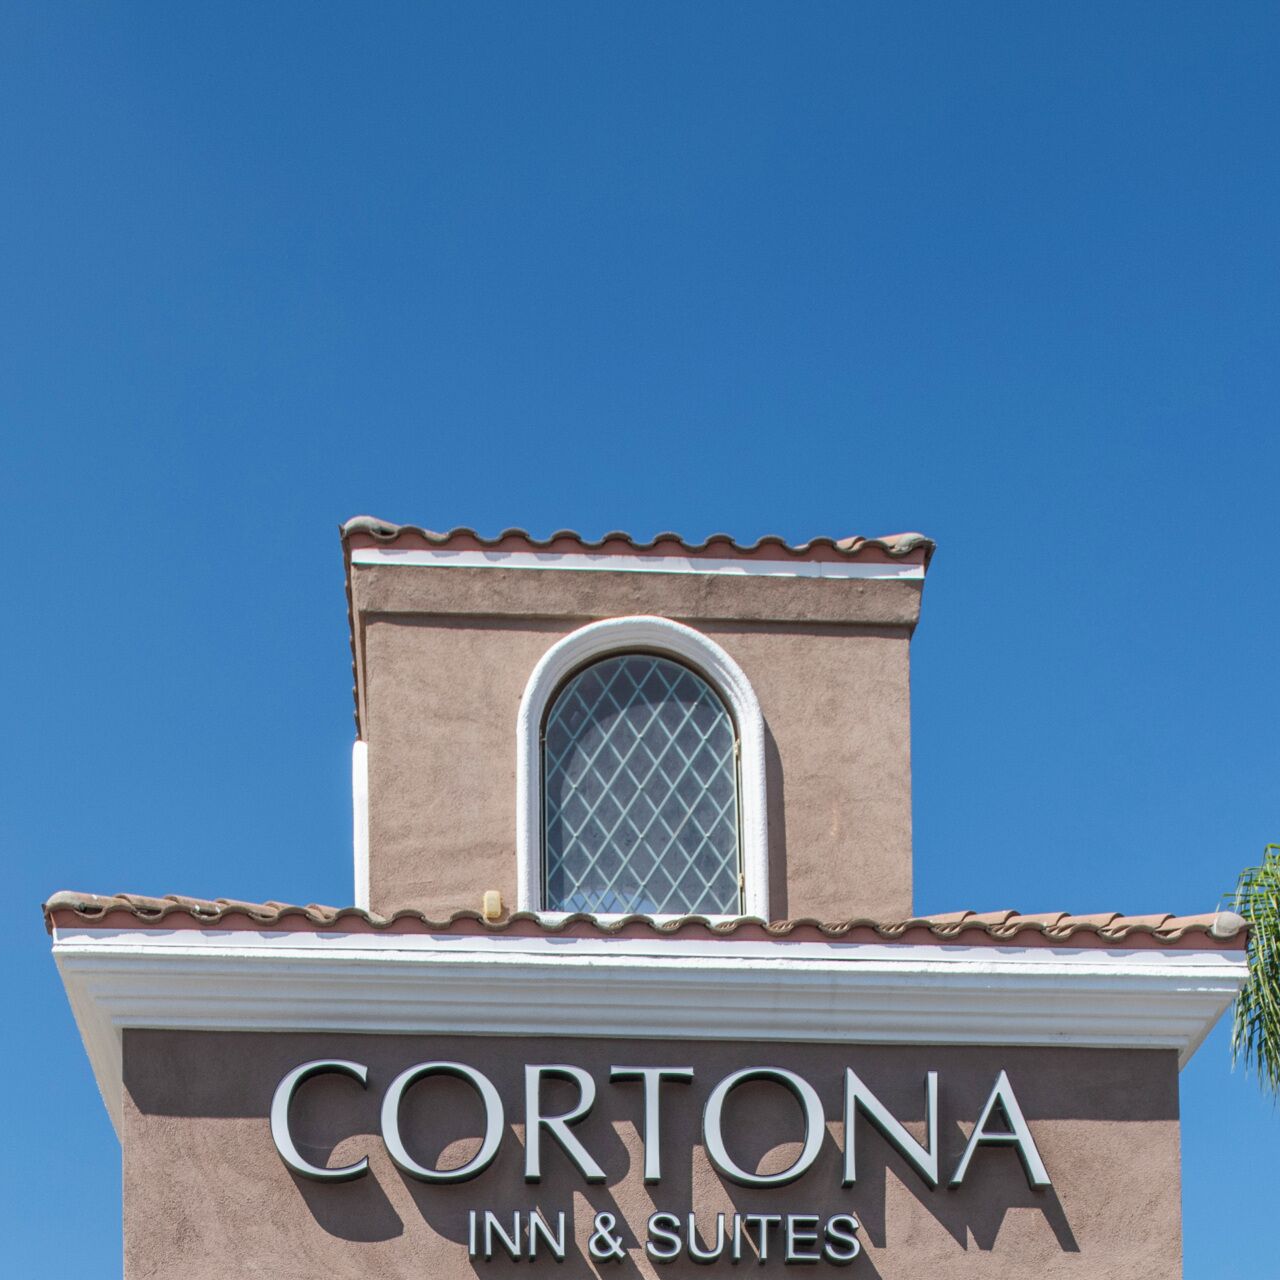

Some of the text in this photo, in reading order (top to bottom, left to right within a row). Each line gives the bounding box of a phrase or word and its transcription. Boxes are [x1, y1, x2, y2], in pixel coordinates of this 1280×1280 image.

[270, 1059, 1051, 1190] CORTONA
[468, 1210, 861, 1266] INN & SUITES
